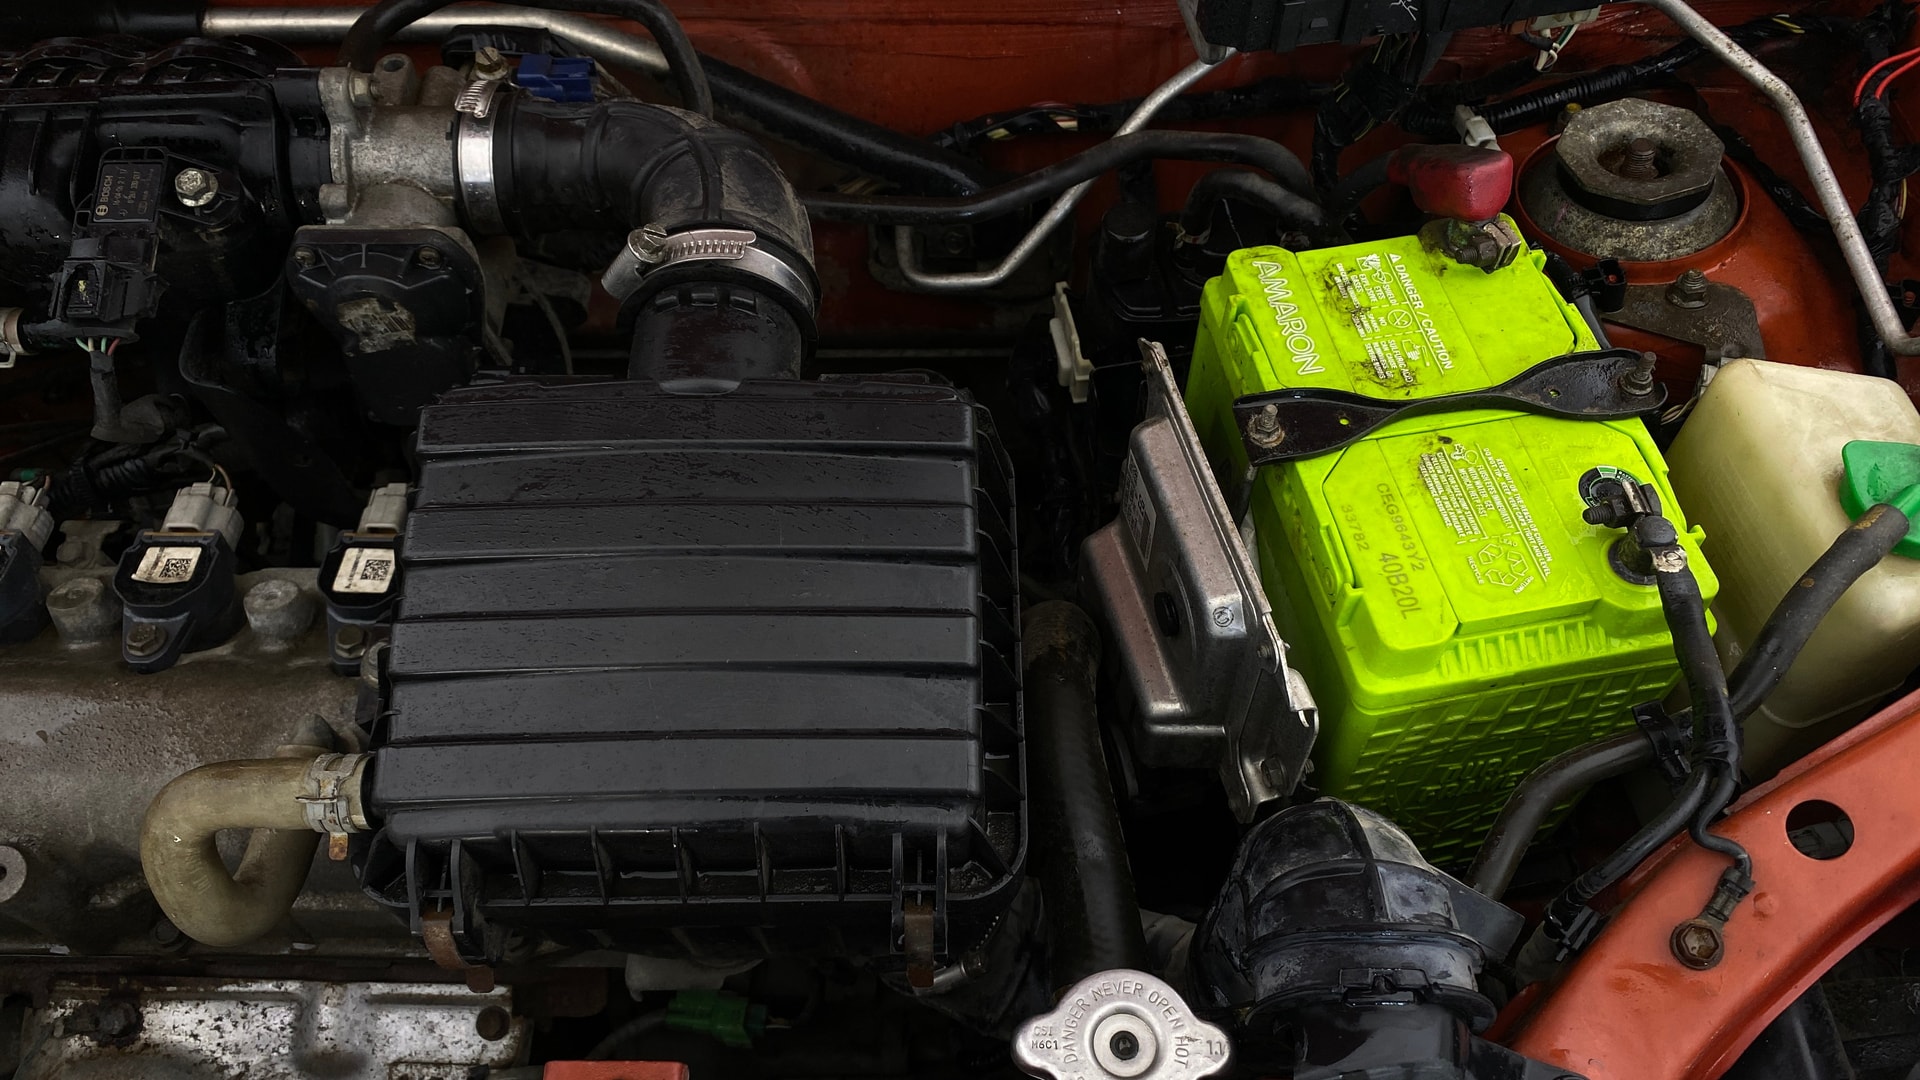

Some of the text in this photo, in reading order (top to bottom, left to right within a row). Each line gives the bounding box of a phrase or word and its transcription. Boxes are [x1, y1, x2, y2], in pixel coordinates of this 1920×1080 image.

[100, 175, 113, 202] BOSCH
[1350, 275, 1364, 292] GASES
[1373, 286, 1385, 298] EYES
[1252, 261, 1325, 375] AMARON
[1359, 315, 1372, 333] FLAMES
[1367, 313, 1380, 331] SPARKS
[1377, 317, 1387, 325] NO
[1394, 264, 1424, 308] DANGER
[1420, 319, 1454, 368] CAUTION
[1364, 343, 1377, 361] SEVERE
[1379, 341, 1397, 368] CAN CAUSE
[1387, 340, 1406, 367] SULFURIC
[1424, 478, 1437, 495] SERVICE
[1457, 468, 1487, 517] MEDICAL HELP FAST
[1467, 467, 1479, 479] WITH
[1484, 501, 1494, 510] GET
[1476, 465, 1490, 480] FLUSH
[1484, 481, 1496, 493] EYES
[1447, 474, 1456, 483] FOR
[1452, 485, 1462, 495] SAFE
[1464, 511, 1480, 534] STARTING
[1486, 456, 1496, 466] NOT
[1500, 481, 1511, 494] KEEP
[1507, 497, 1519, 510] VENT
[1515, 511, 1527, 525] CAPS
[1523, 528, 1536, 543] TIGHT
[1531, 545, 1542, 556] AND
[1538, 558, 1551, 574] LEVEL
[1495, 457, 1507, 472] KEEP
[1503, 472, 1513, 482] OUT
[1509, 484, 1518, 492] OF
[1514, 493, 1523, 503] THE
[1519, 504, 1533, 522] REACH
[1533, 533, 1552, 561] CHILDREN
[1342, 506, 1369, 551] 33782
[1376, 483, 1425, 571] CEG9643Y2
[1468, 556, 1485, 584] RECYCLE
[1378, 553, 1421, 619] 40B20L
[1062, 980, 1190, 1068] DANGER NEVER OPEN HOT
